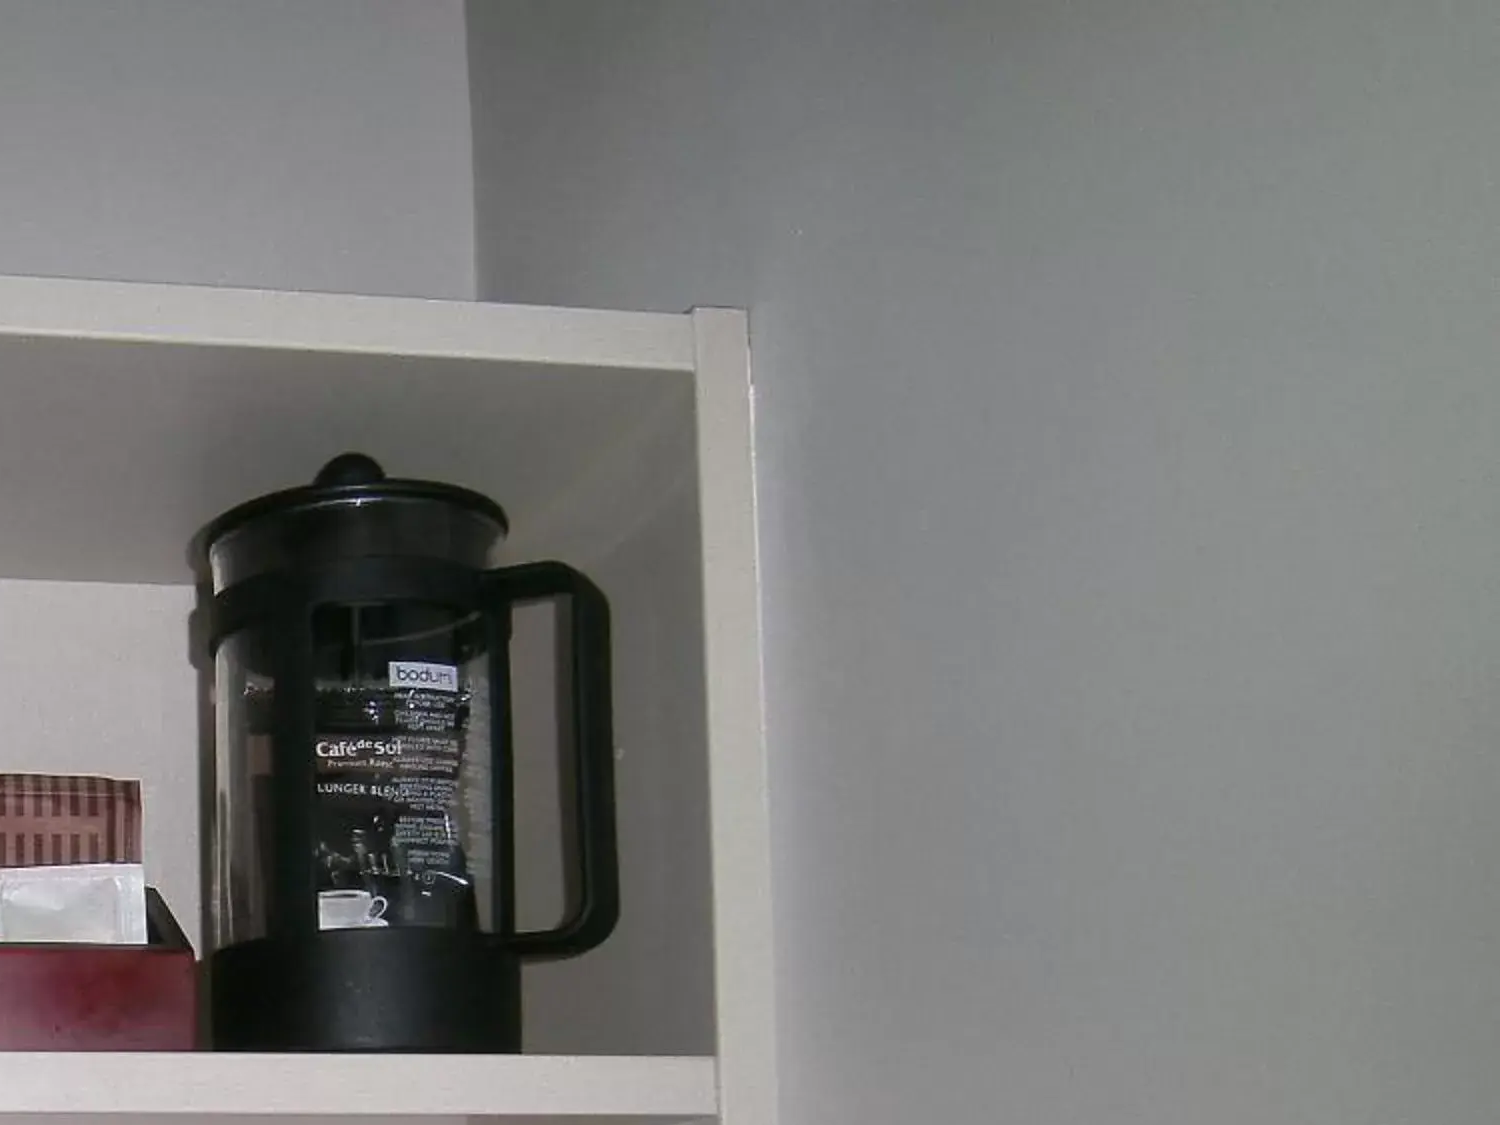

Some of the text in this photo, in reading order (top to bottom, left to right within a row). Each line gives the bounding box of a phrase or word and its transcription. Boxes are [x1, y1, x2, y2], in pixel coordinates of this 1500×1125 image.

[316, 741, 358, 757] Café
[357, 739, 374, 749] de
[374, 739, 401, 755] Sol
[316, 783, 367, 795] LUNGER
